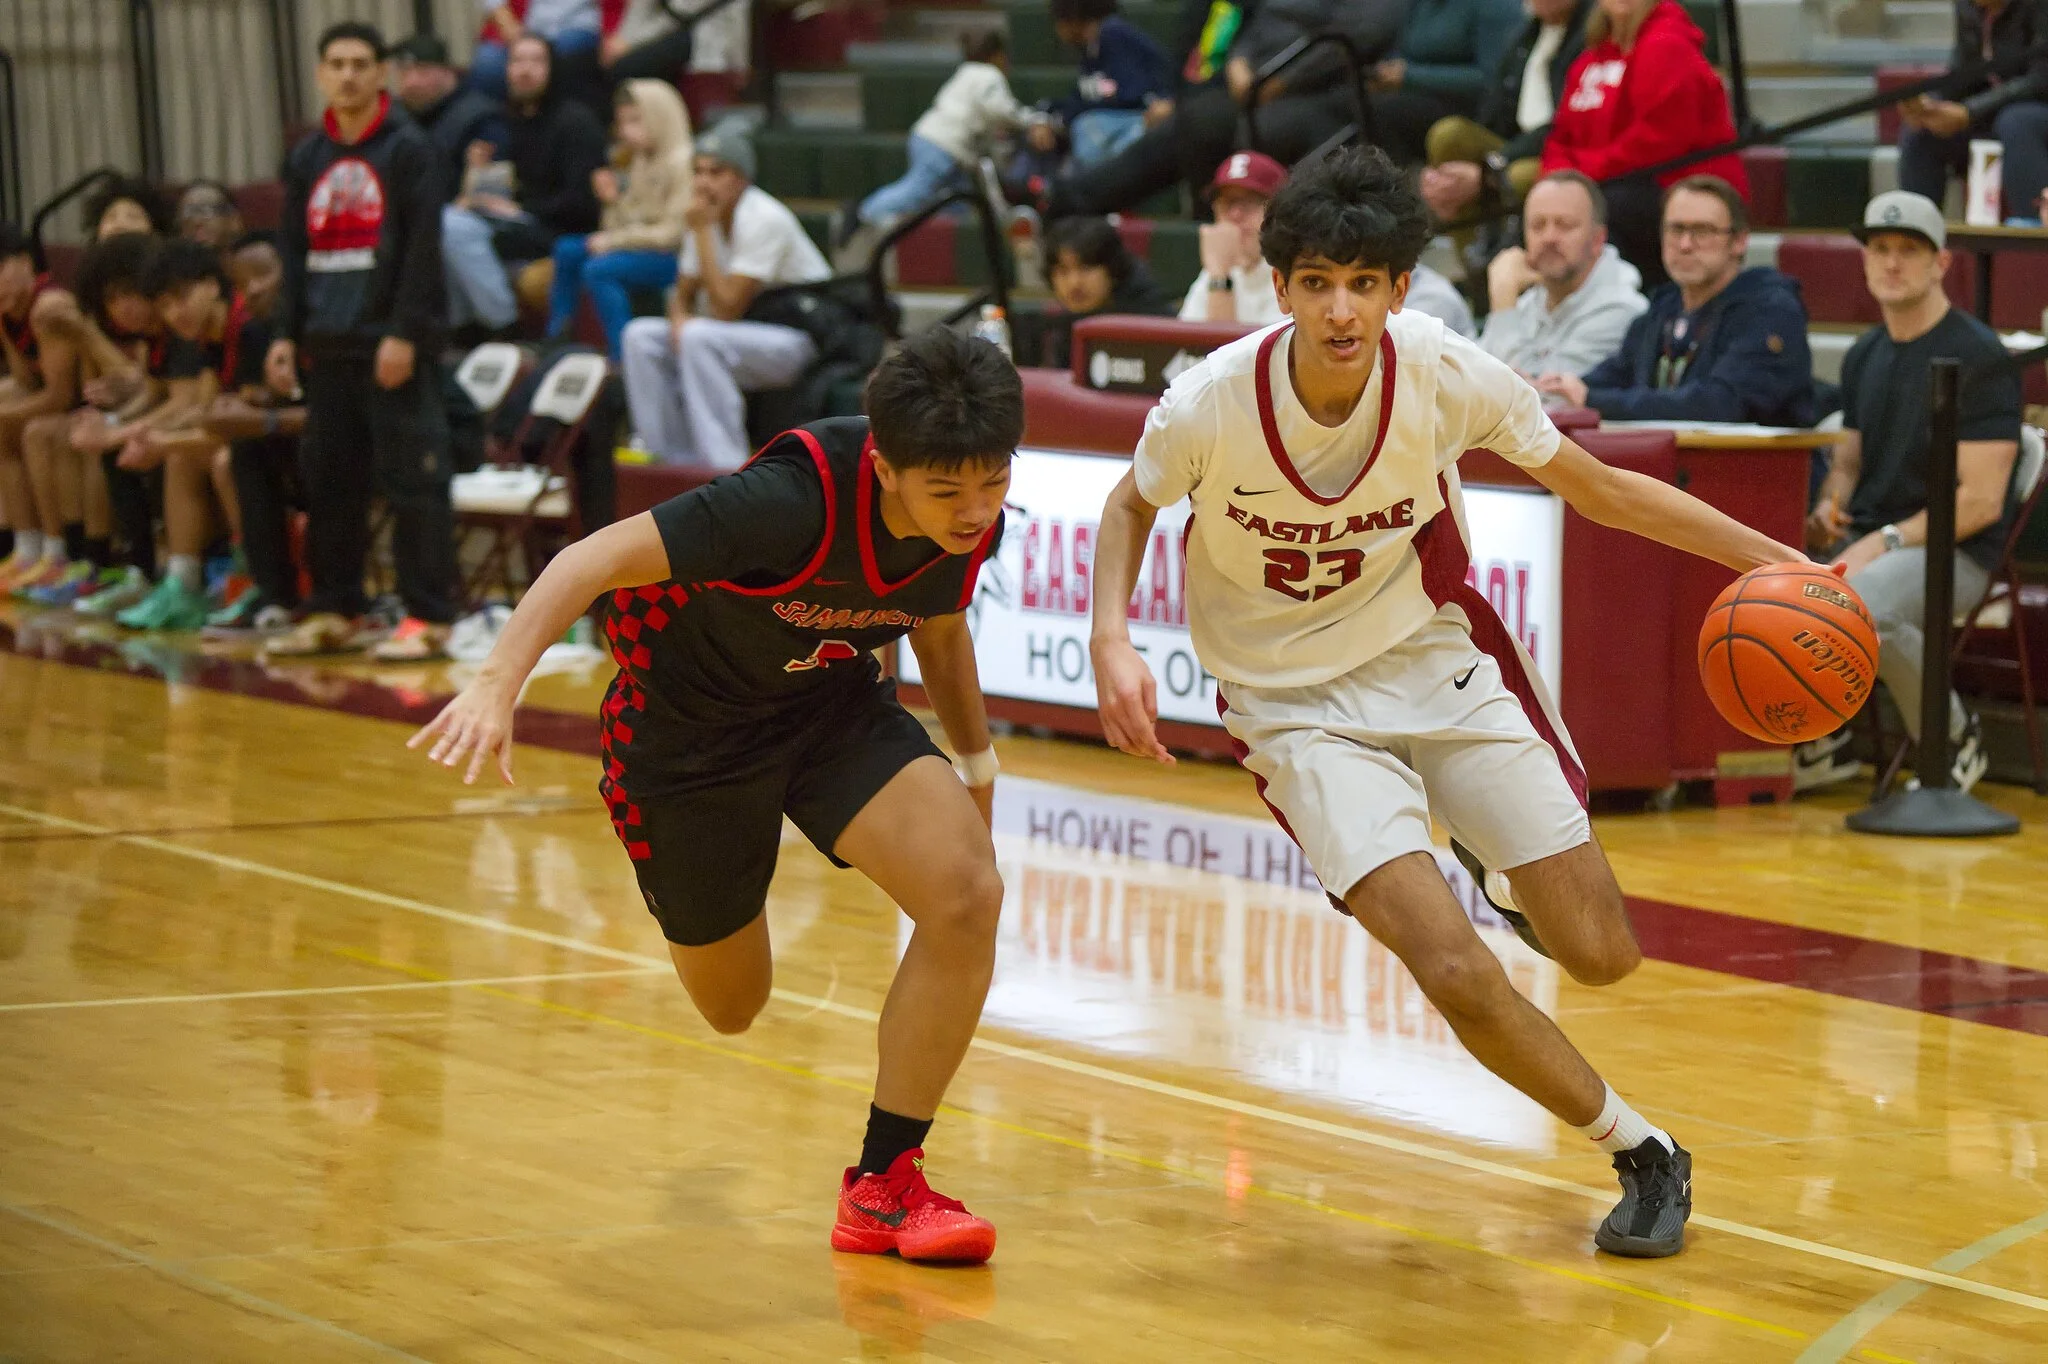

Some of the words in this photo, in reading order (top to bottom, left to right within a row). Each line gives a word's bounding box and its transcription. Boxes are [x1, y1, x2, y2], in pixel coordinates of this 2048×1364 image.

[1228, 154, 1250, 178] E
[1225, 498, 1414, 544] EASTLAKE
[1262, 548, 1366, 602] 23
[1792, 630, 1870, 705] Baden
